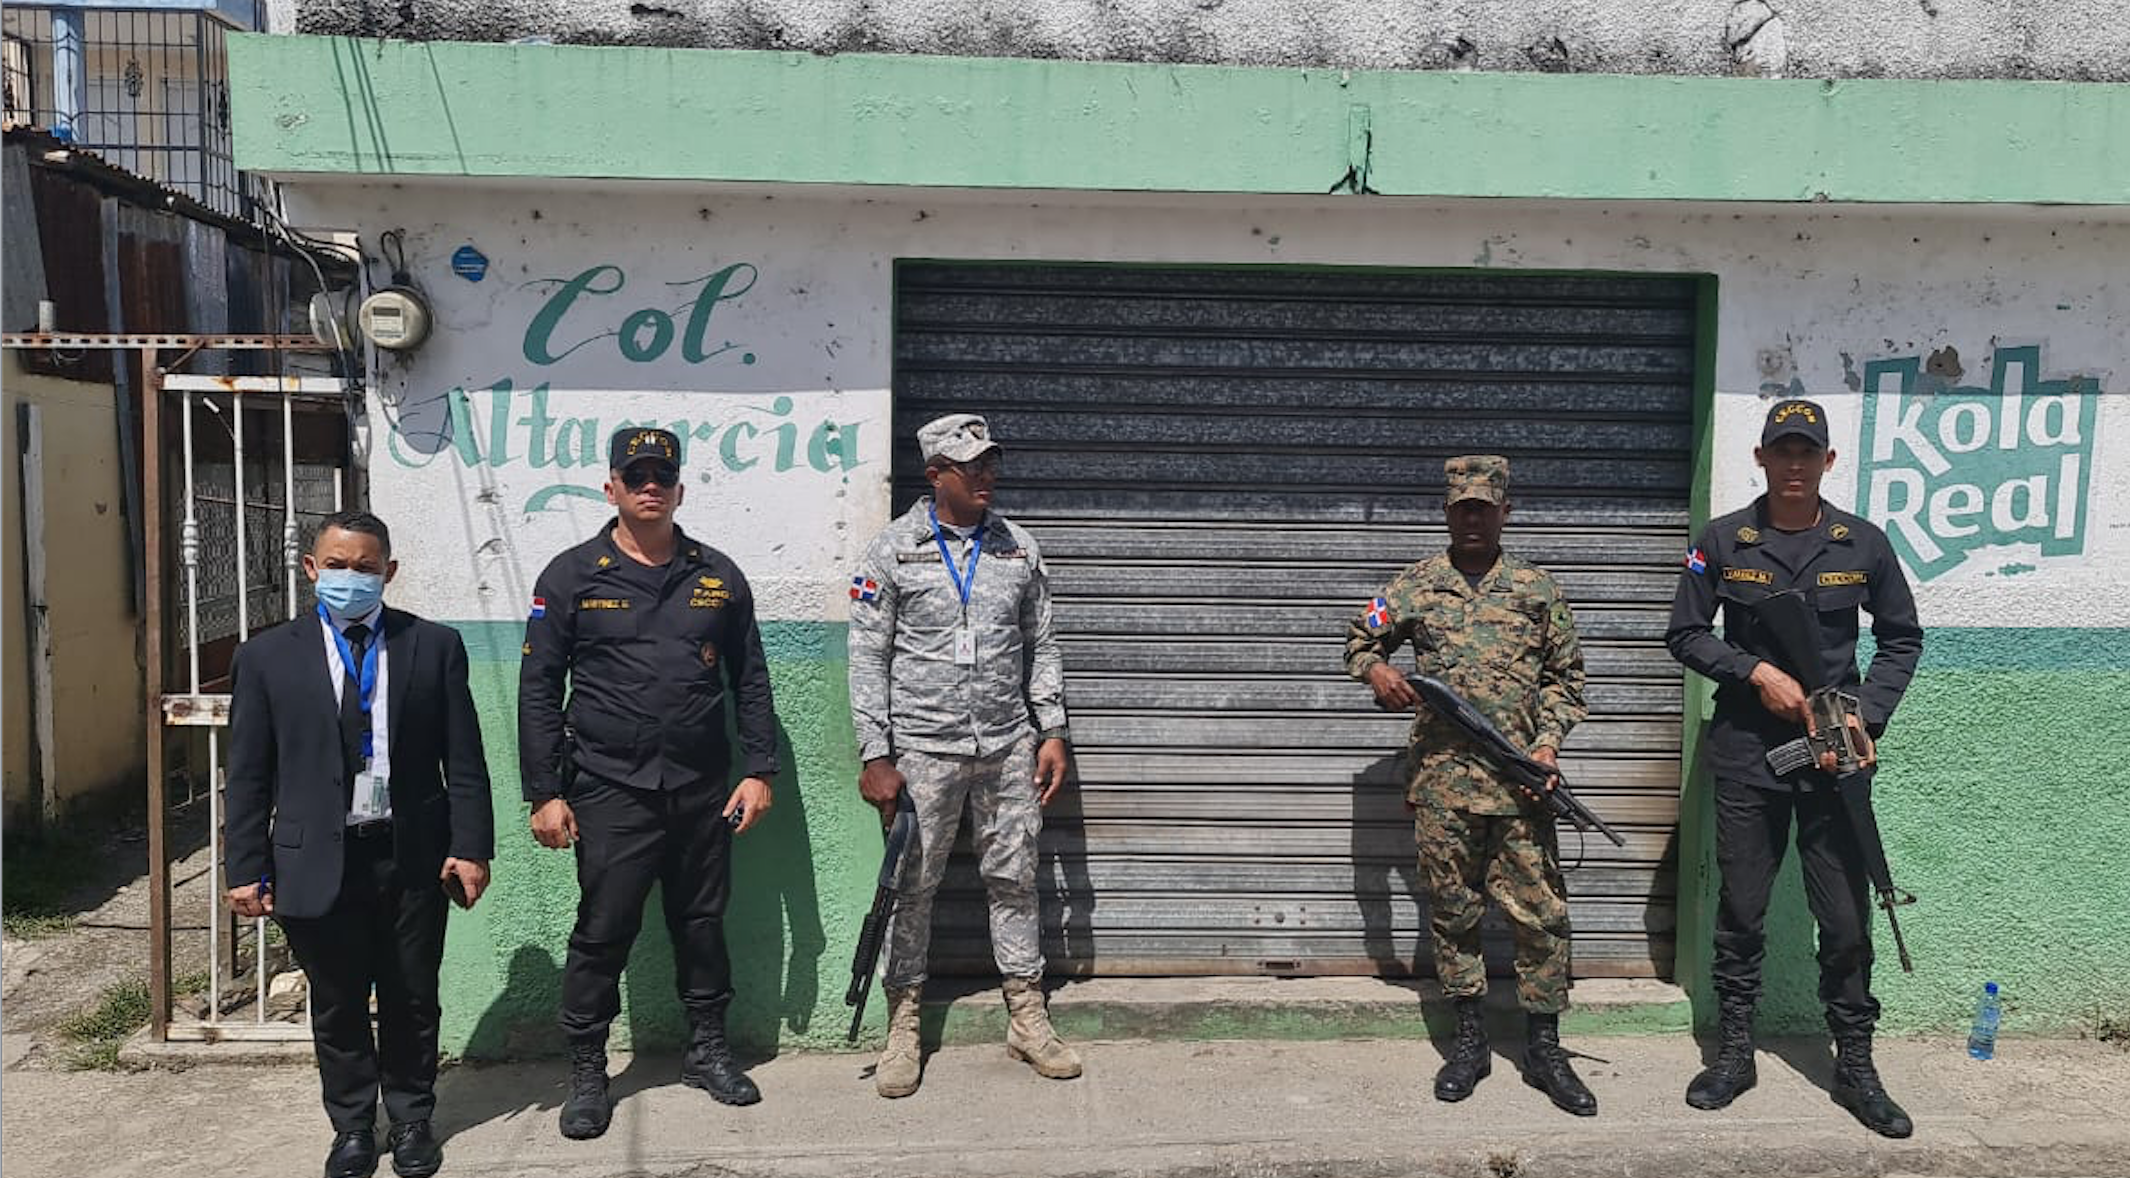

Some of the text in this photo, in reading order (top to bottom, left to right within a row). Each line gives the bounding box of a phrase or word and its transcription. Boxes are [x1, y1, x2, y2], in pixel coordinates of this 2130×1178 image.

[521, 262, 759, 366] Col.
[389, 377, 872, 470] Altarcia
[1868, 453, 2080, 564] Real
